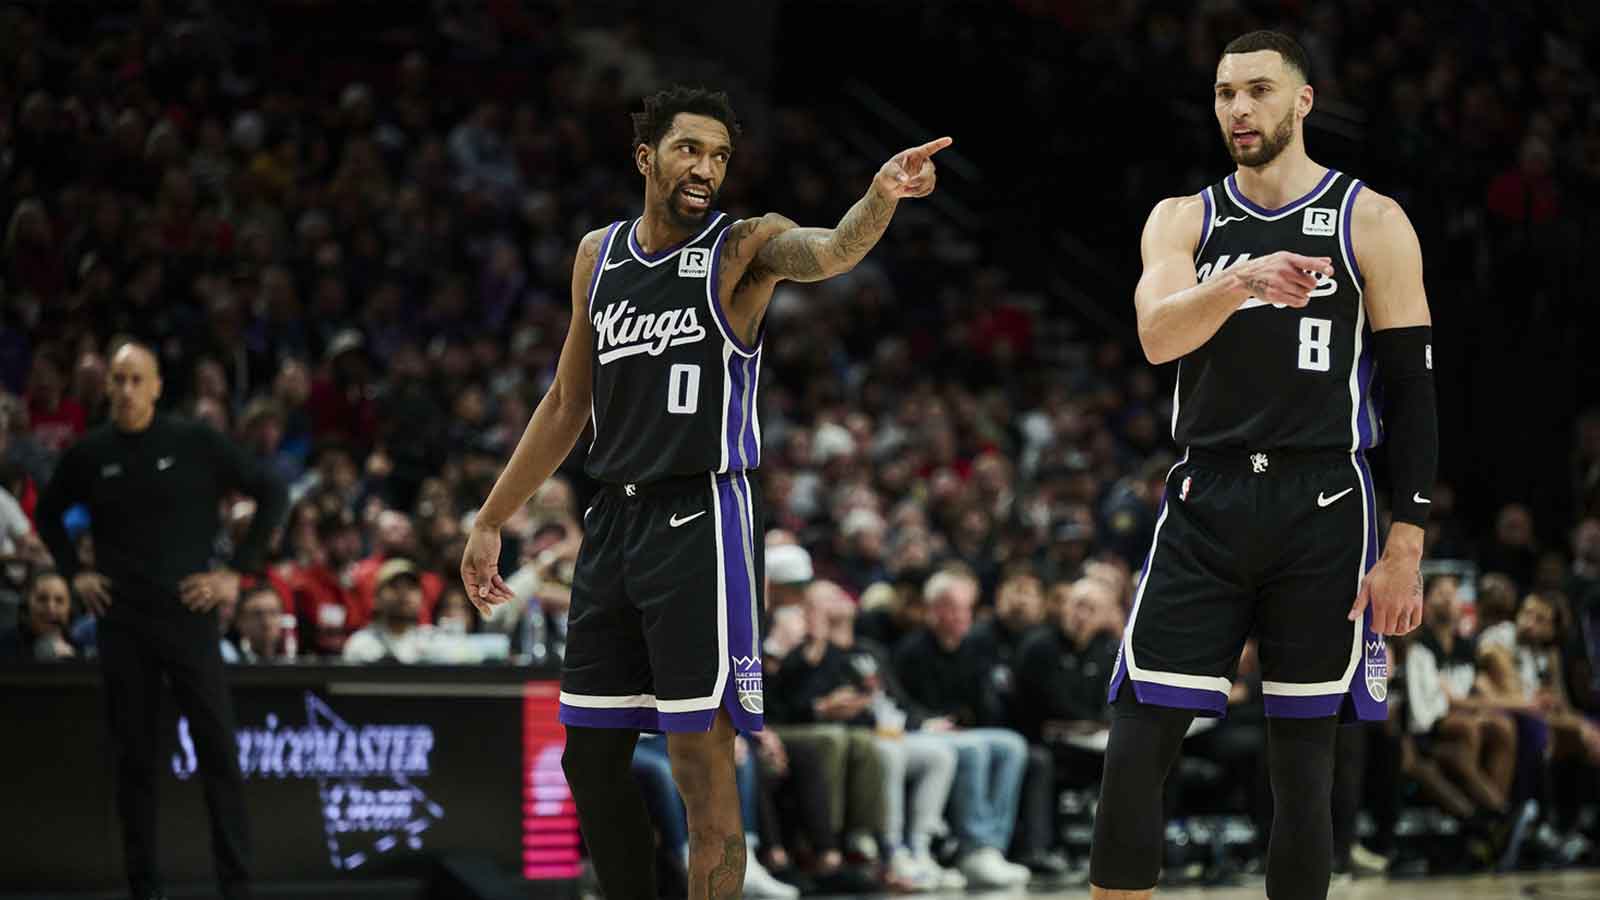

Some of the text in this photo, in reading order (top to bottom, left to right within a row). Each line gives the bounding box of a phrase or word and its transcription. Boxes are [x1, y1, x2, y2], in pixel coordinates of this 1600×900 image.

[1311, 211, 1330, 225] R
[686, 251, 704, 266] R
[593, 300, 706, 365] Kings
[1298, 317, 1332, 371] 8
[667, 363, 701, 414] 0
